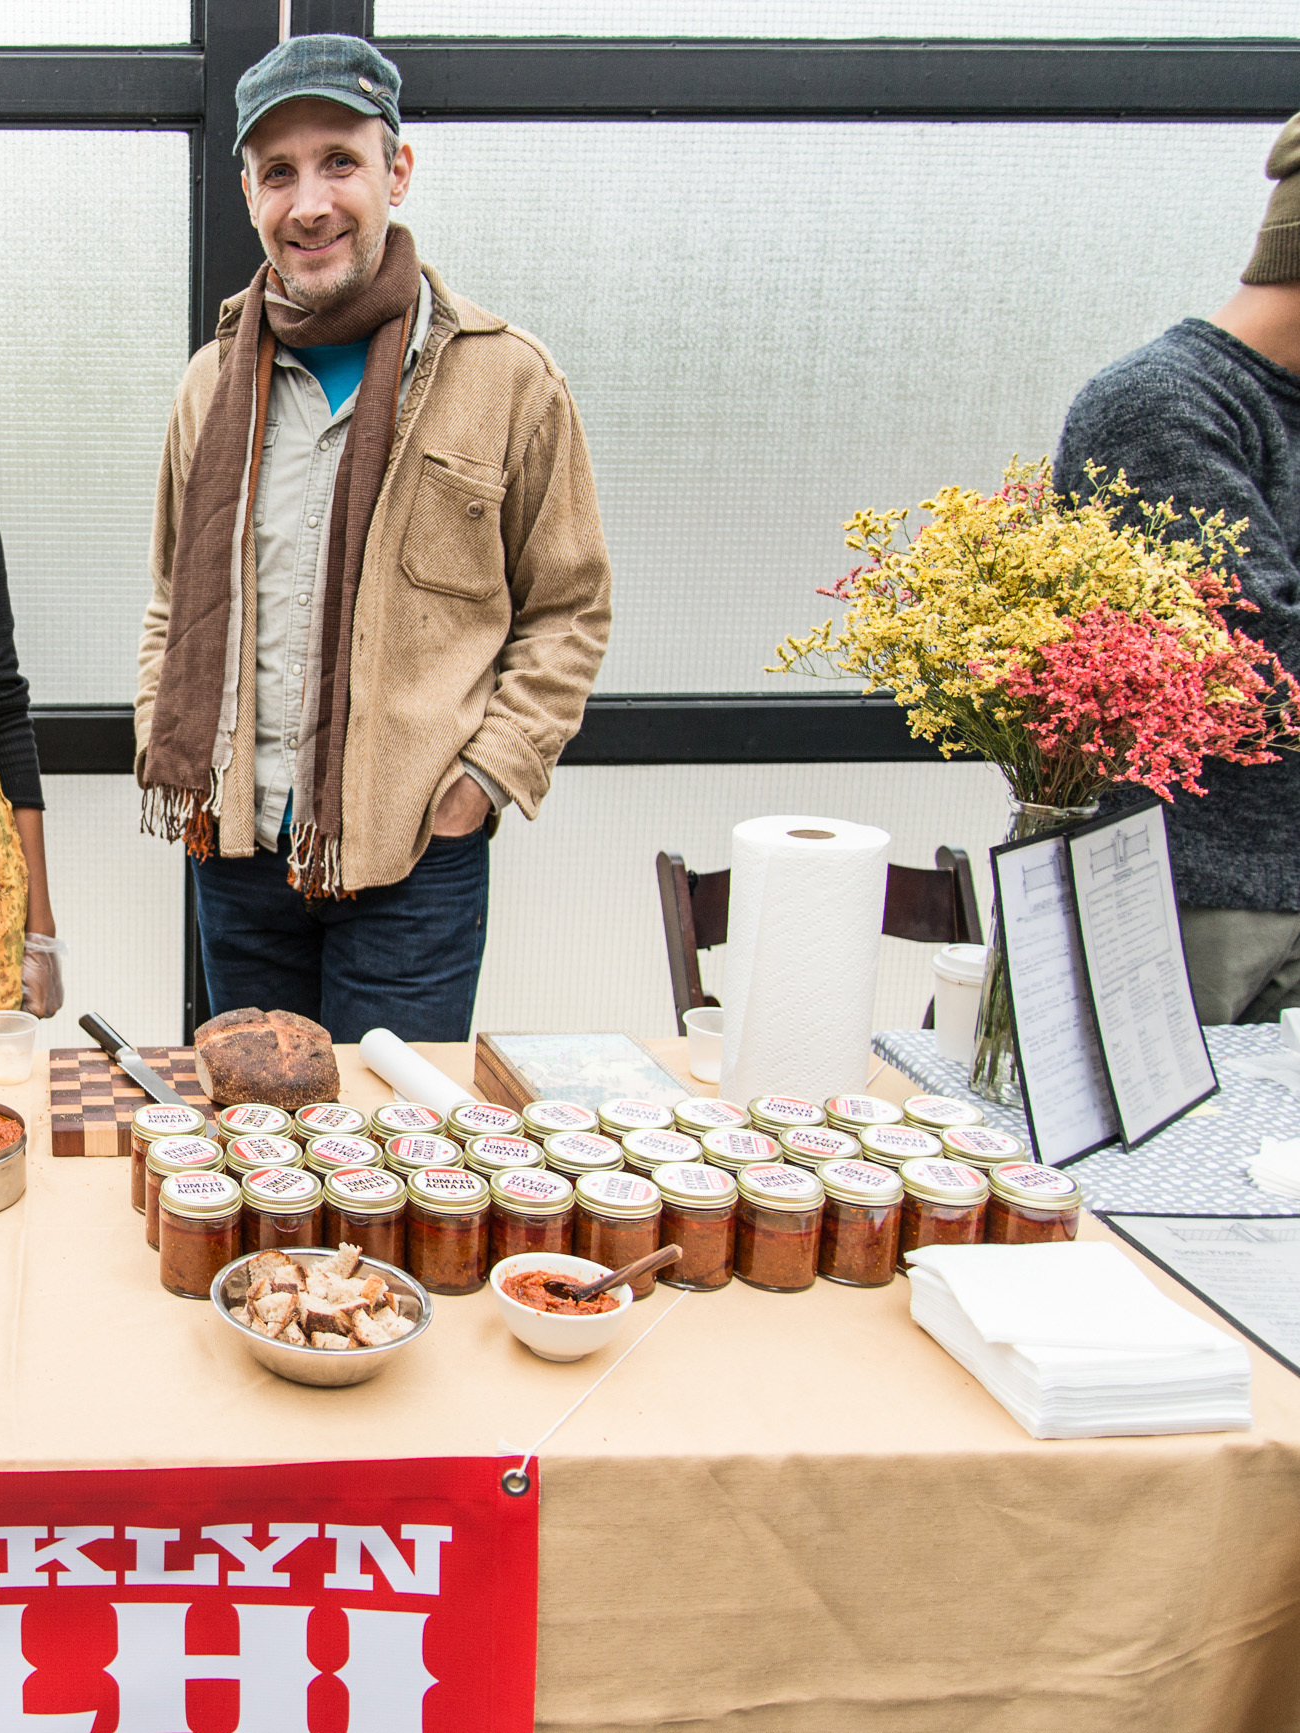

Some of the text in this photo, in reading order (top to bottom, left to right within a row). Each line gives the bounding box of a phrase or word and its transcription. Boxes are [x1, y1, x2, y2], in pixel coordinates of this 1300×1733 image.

[616, 1105, 660, 1116] TOMATO
[764, 1106, 812, 1117] ACHAAR
[768, 1102, 813, 1113] TOMATO
[461, 1113, 505, 1126] ACHAAR
[468, 1110, 509, 1122] TOMATO
[613, 1108, 660, 1120] ACHAAR
[643, 1136, 688, 1151] TOMATO
[793, 1136, 839, 1149] TOMATO
[795, 1132, 845, 1146] ACHAAR
[876, 1134, 926, 1143] TOMATO
[876, 1139, 928, 1148] ACHAAR
[163, 1141, 201, 1155] ACHAAR
[321, 1143, 359, 1159] TOMATO
[328, 1140, 369, 1156] ACHAAR
[484, 1144, 528, 1153] TOMATO
[559, 1140, 602, 1158] ACHAAR
[567, 1137, 606, 1154] TOMATO
[636, 1138, 684, 1154] ACHAAR
[170, 1147, 208, 1159] TOMATO
[480, 1148, 528, 1158] ACHAAR
[754, 1173, 796, 1183] TOMATO
[832, 1168, 880, 1186] ACHAAR
[840, 1166, 885, 1183] TOMATO
[1010, 1172, 1049, 1182] TOMATO
[262, 1172, 294, 1190] TOMATO
[272, 1175, 305, 1194] ACHAAR
[342, 1175, 383, 1187] TOMATO
[350, 1180, 391, 1192] ACHAAR
[512, 1175, 561, 1191] ACHAAR
[761, 1177, 804, 1188] ACHAAR
[1019, 1175, 1058, 1187] ACHAAR
[508, 1181, 553, 1194] TOMATO
